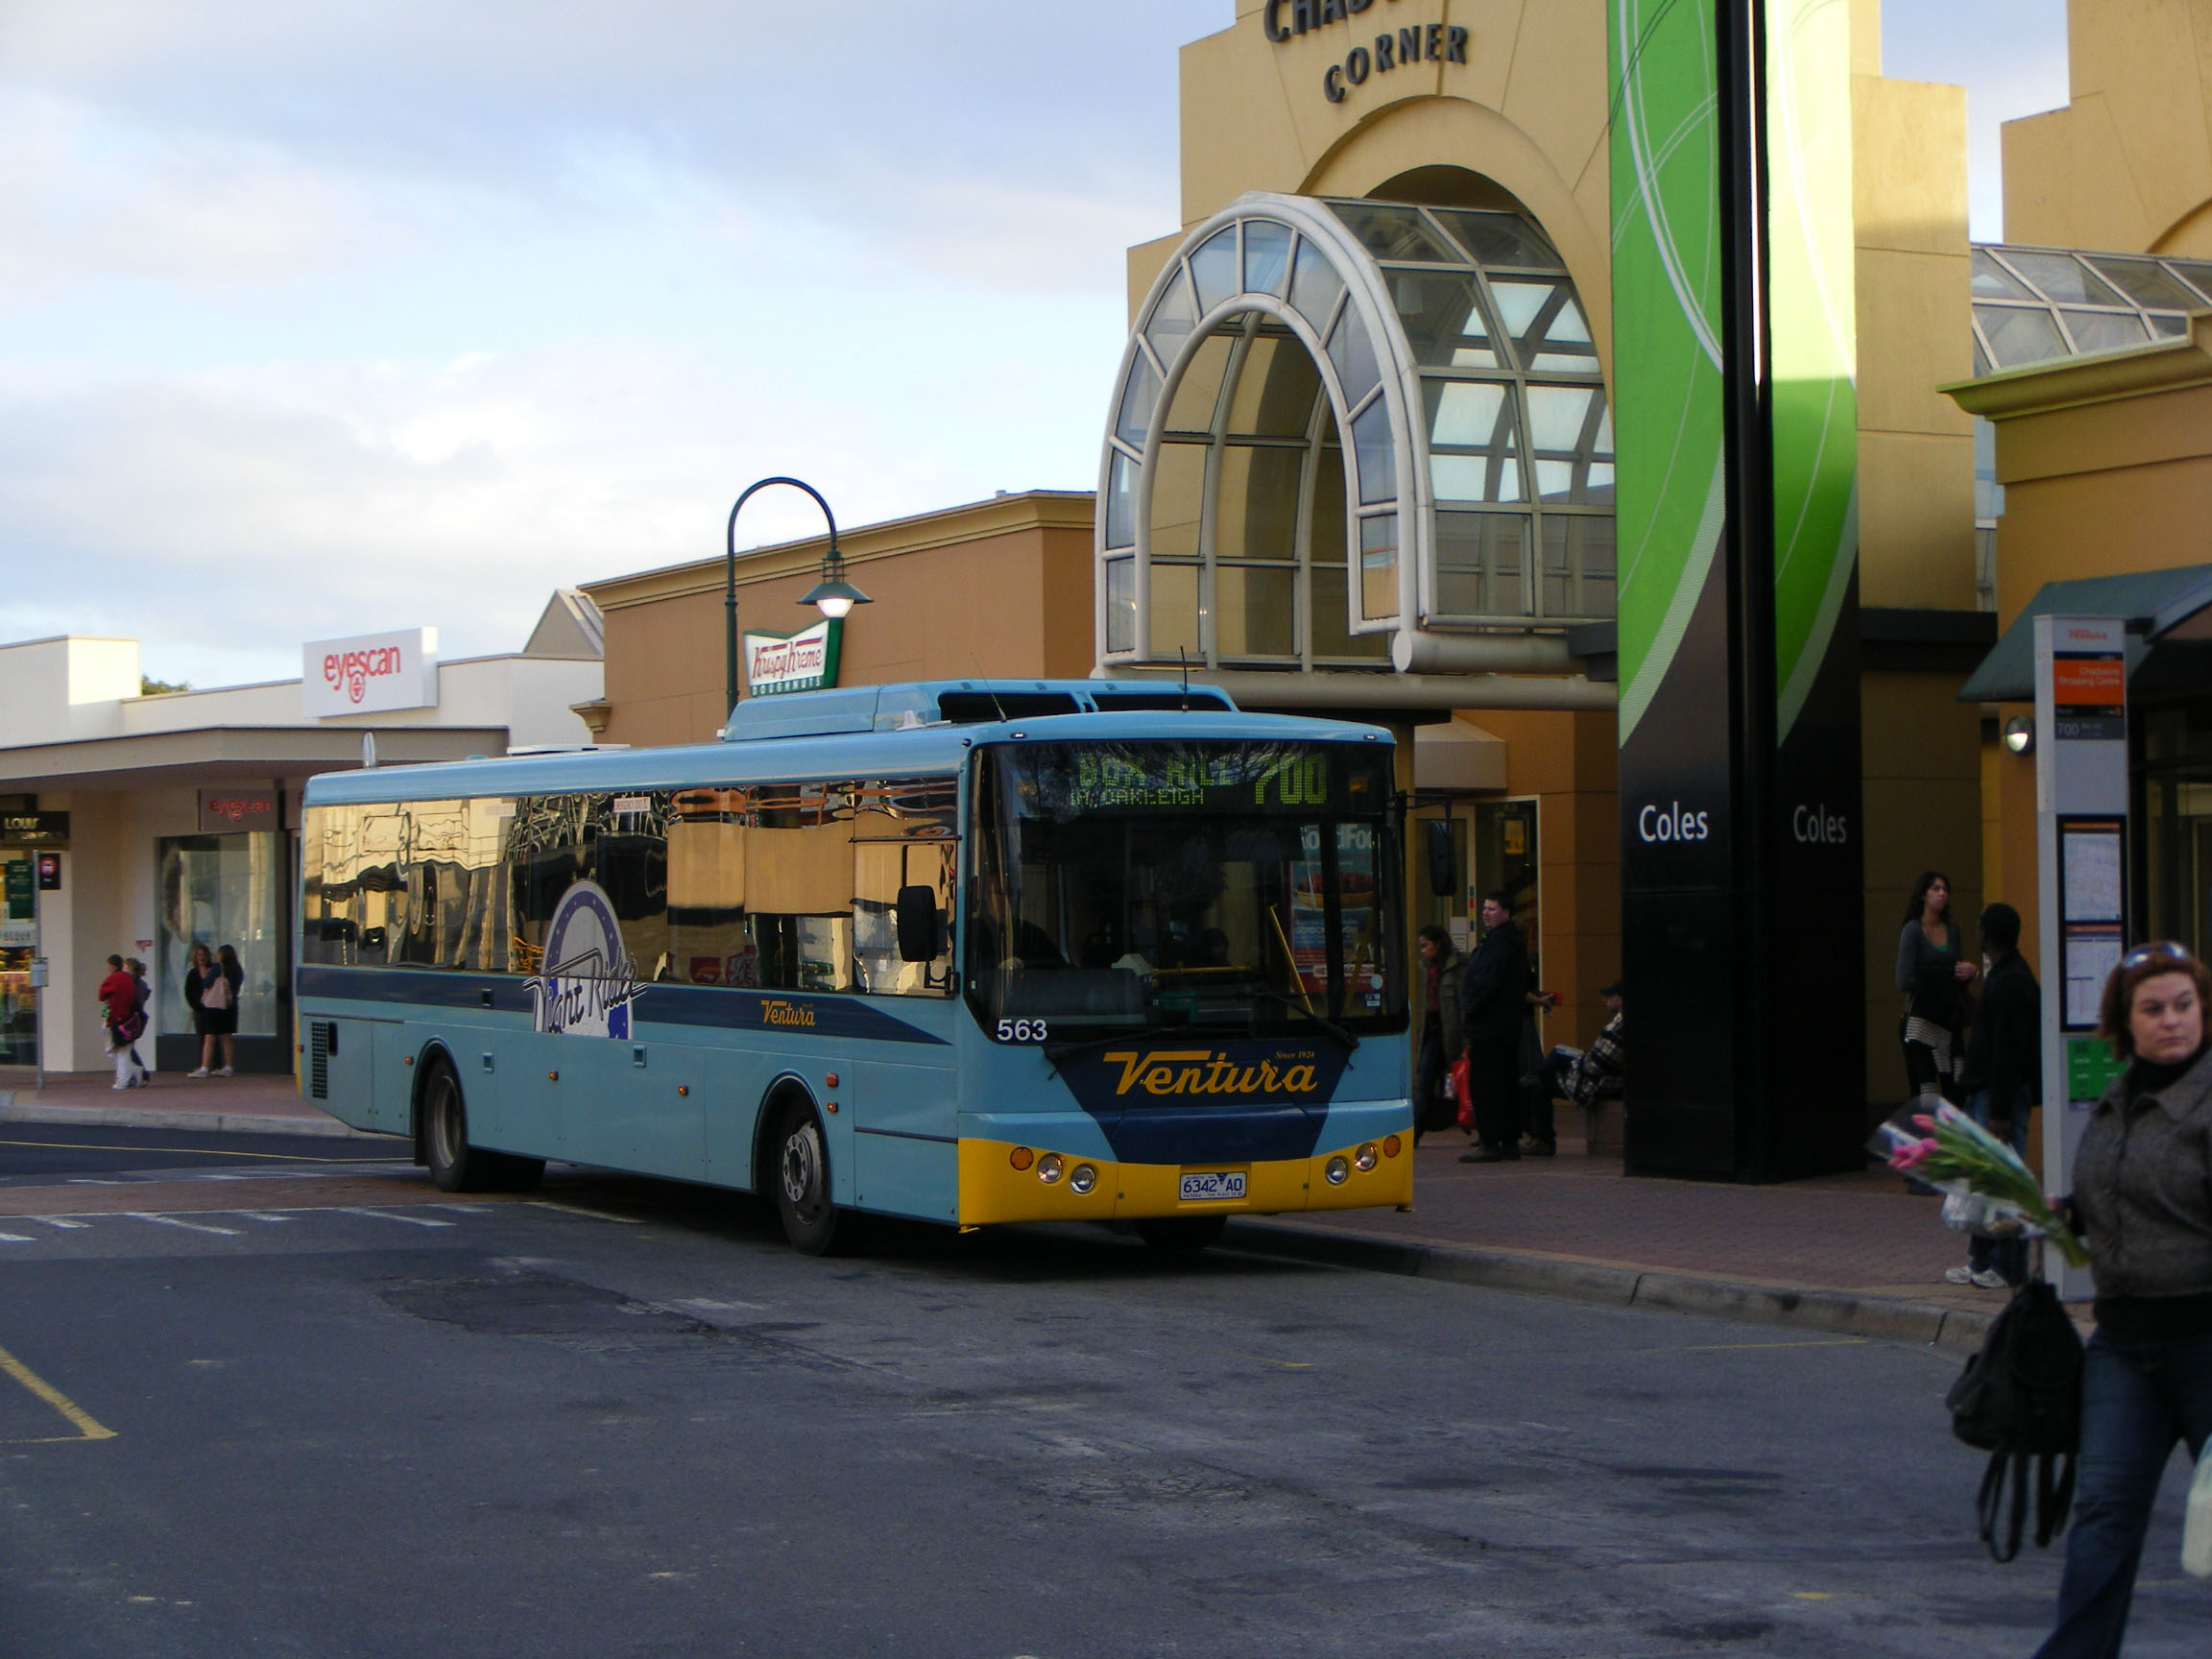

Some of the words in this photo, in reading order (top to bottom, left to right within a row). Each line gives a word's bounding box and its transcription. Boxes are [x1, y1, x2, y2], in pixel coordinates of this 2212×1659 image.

[1323, 23, 1469, 103] CORNER
[323, 646, 401, 692] eyescan
[1079, 753, 1143, 786] BOX
[1254, 753, 1327, 805] 700
[209, 800, 272, 816] eyescan
[1102, 788, 1204, 805] OAKLEIGH
[1639, 801, 1709, 842] Coles
[1792, 803, 1848, 843] Coles
[760, 999, 817, 1027] Ventura
[997, 1019, 1048, 1042] 563
[1102, 1049, 1318, 1096] Ventura
[1184, 1179, 1217, 1193] 6342
[1226, 1177, 1242, 1191] AO
